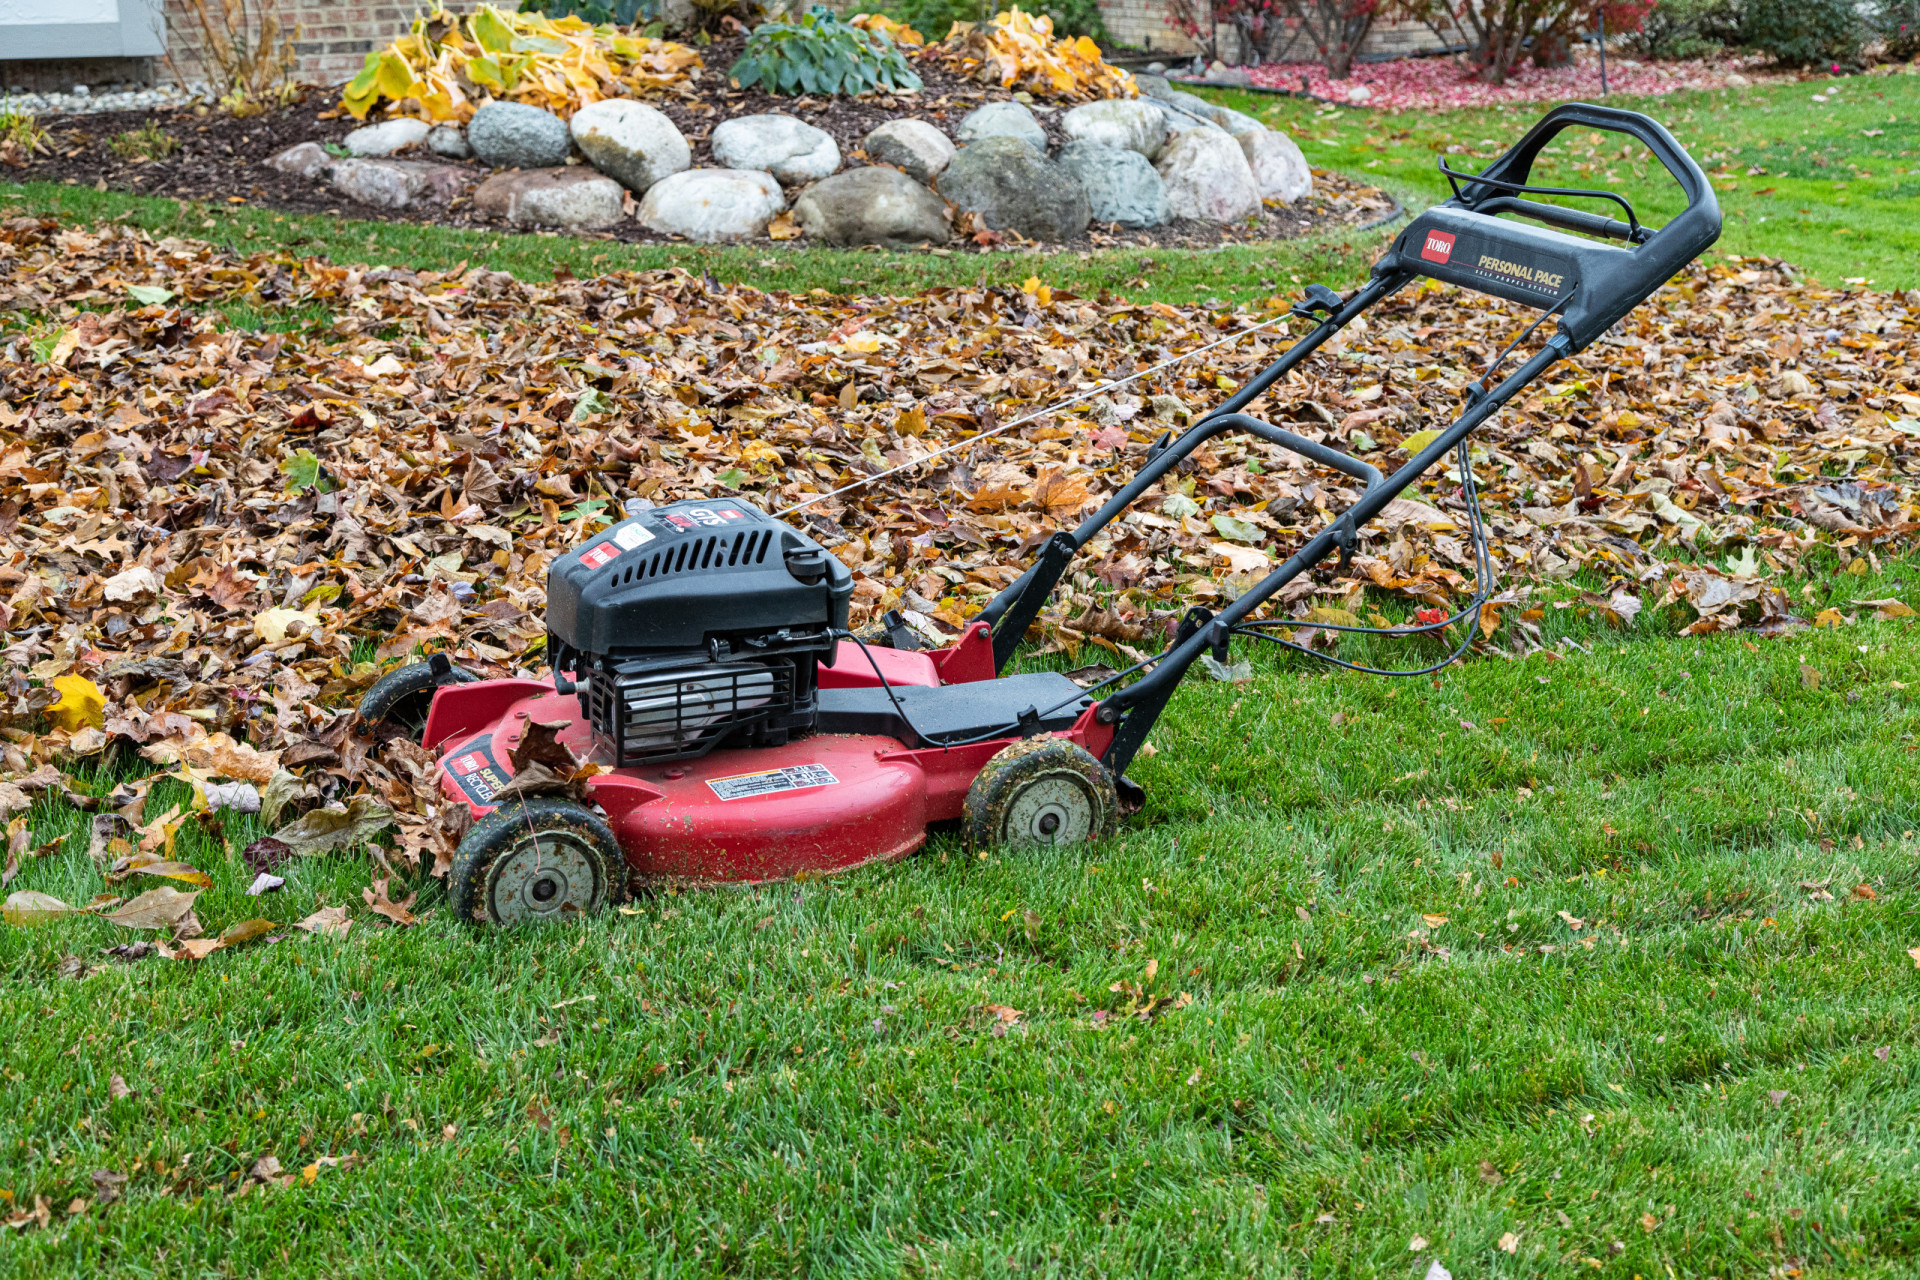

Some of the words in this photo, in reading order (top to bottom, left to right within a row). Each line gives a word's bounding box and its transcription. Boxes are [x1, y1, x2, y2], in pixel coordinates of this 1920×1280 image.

[1426, 237, 1451, 254] TORO
[1475, 269, 1493, 278] SELF
[1496, 274, 1524, 287] PROPEL
[1528, 283, 1558, 296] SYSTEM
[1478, 255, 1533, 281] PERSONAL
[1534, 270, 1563, 288] PACE
[690, 508, 730, 525] GTS
